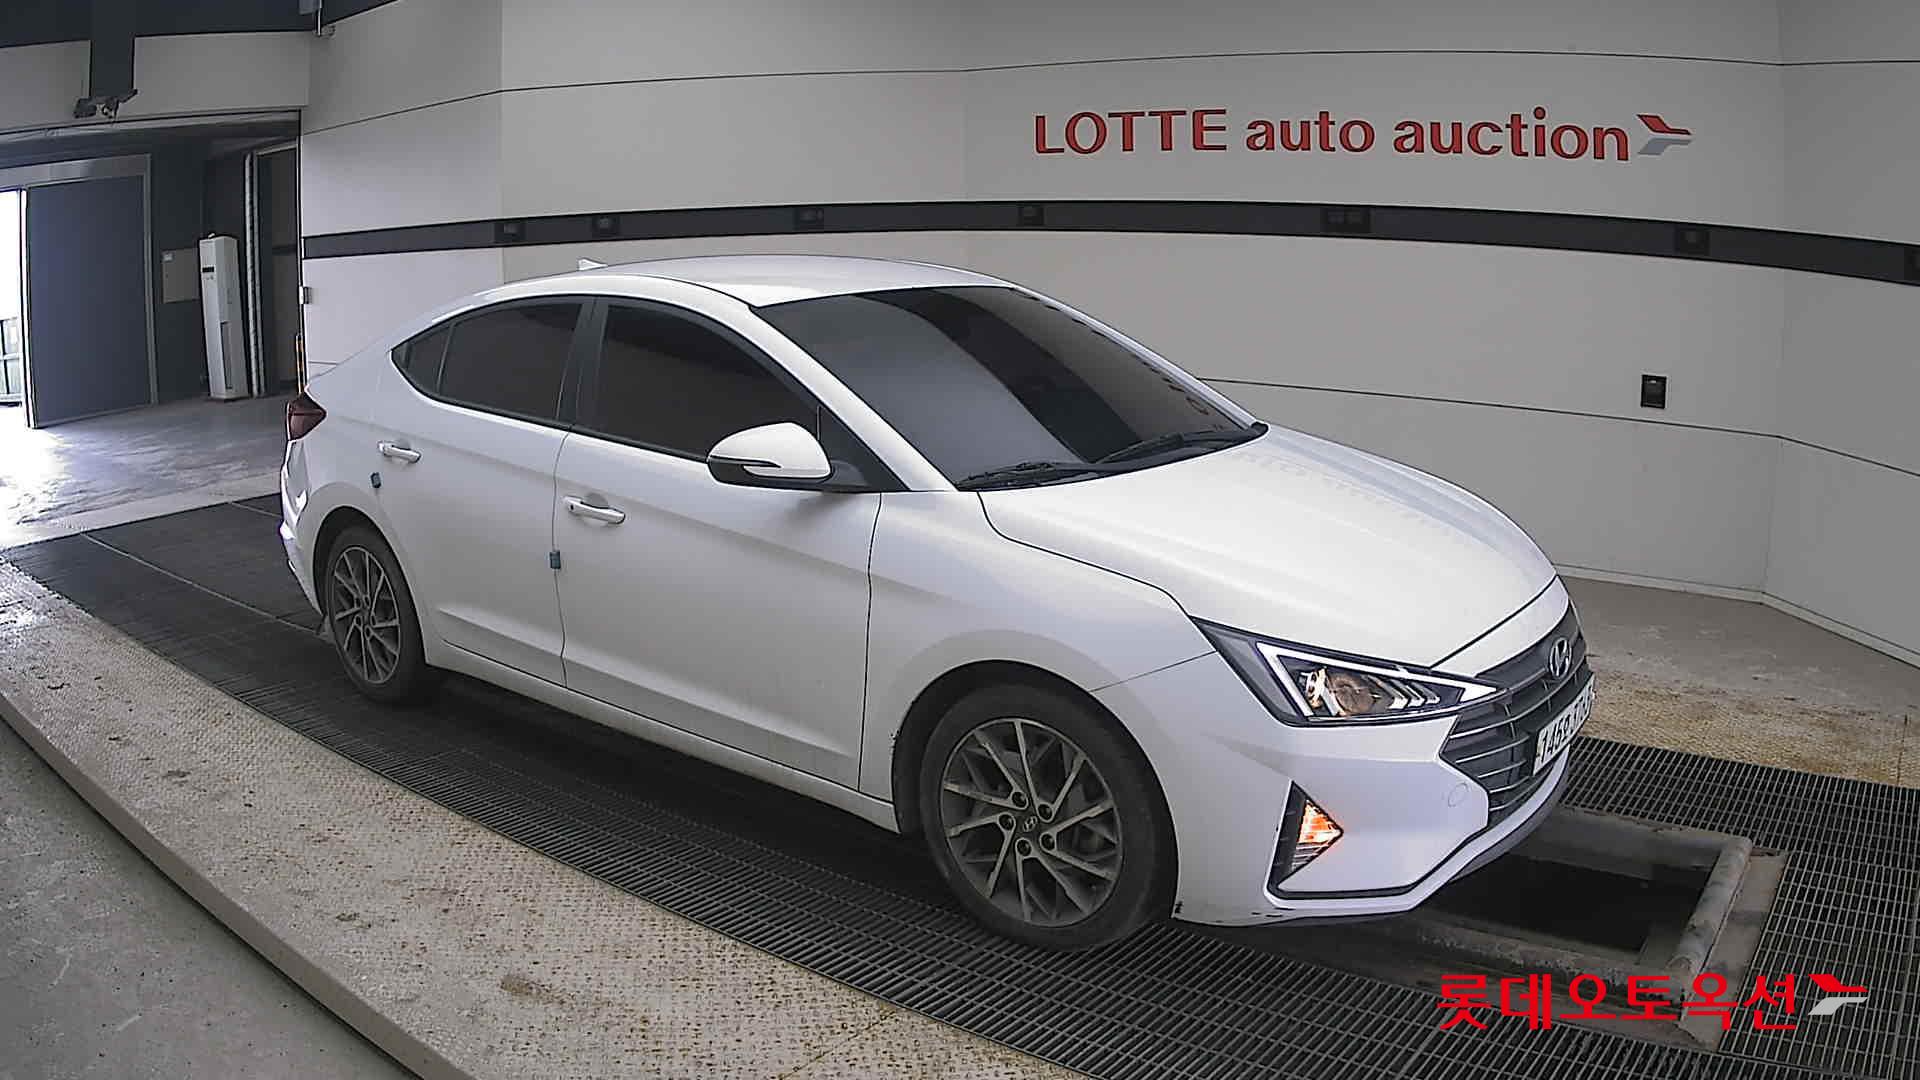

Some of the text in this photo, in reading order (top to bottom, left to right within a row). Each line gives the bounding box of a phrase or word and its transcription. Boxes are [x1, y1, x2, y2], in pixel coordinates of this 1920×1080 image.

[1034, 106, 1629, 160] LOTTE auto auction
